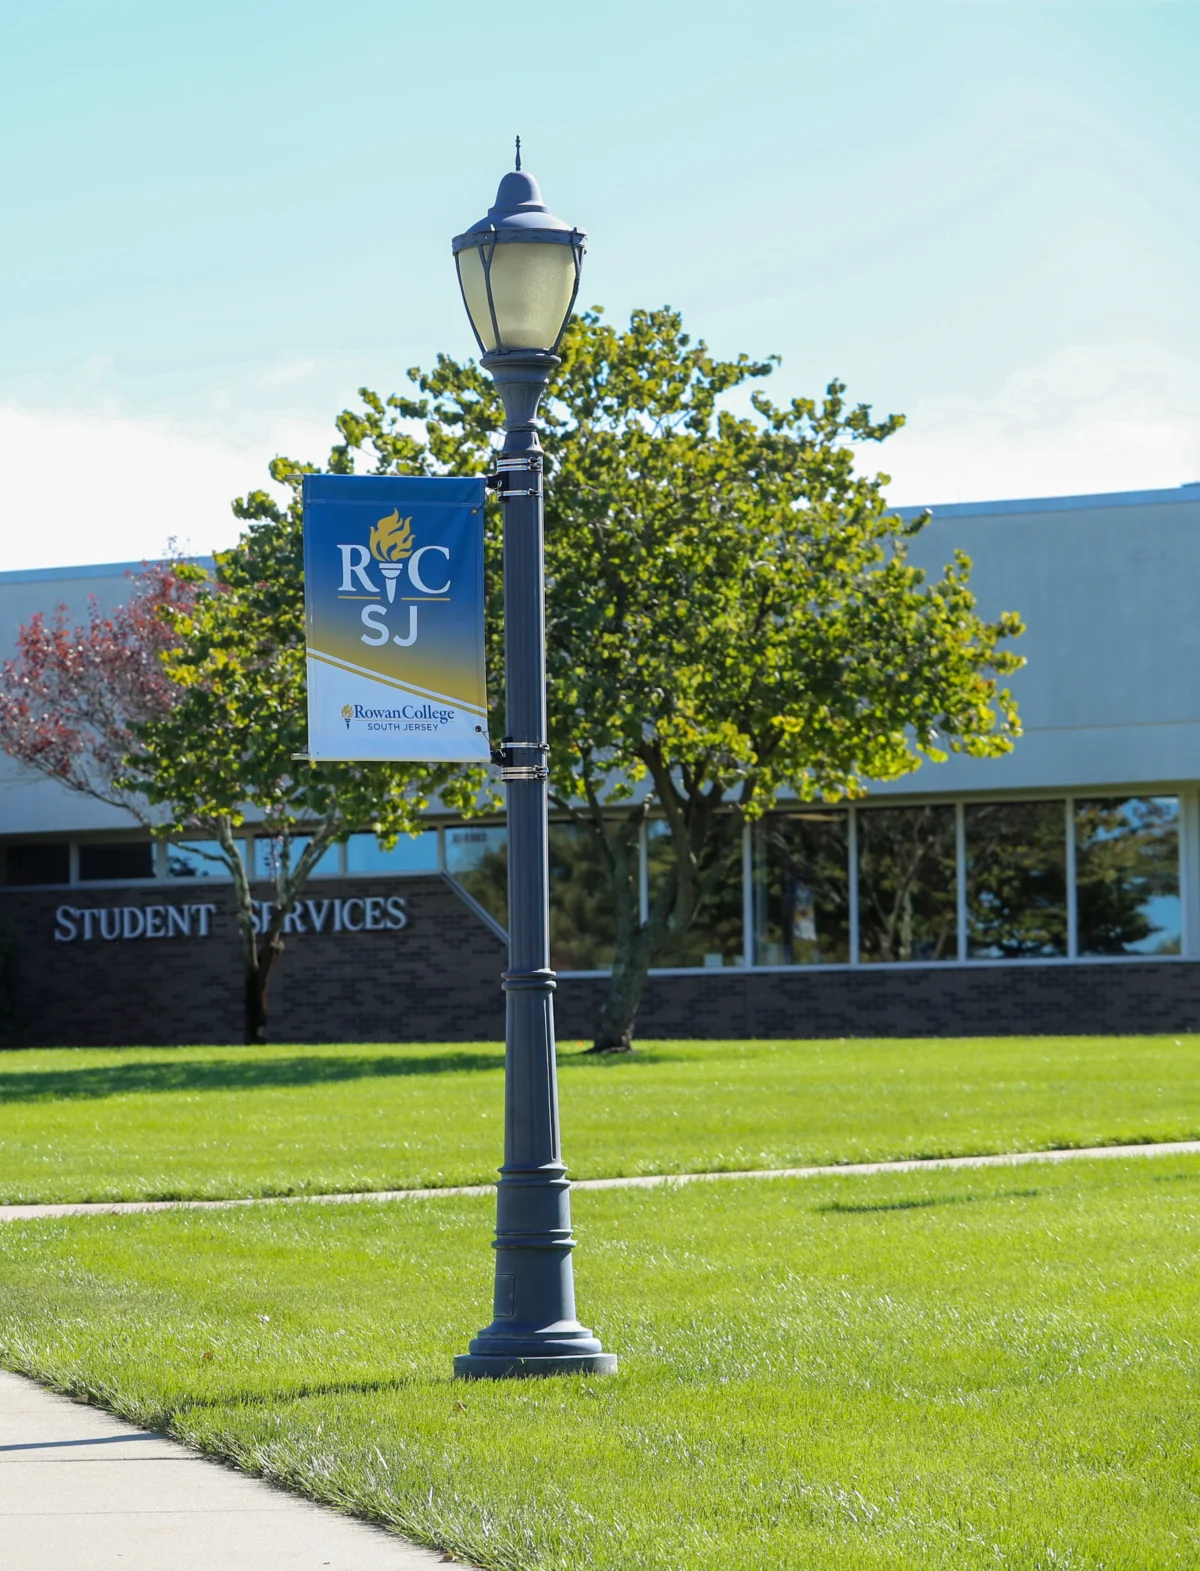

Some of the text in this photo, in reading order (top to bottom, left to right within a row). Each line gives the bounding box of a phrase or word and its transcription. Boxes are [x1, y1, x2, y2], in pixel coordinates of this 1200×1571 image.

[361, 604, 418, 647] SJ
[367, 723, 439, 731] SOUTH JERSEY
[54, 904, 217, 942] STUDENT
